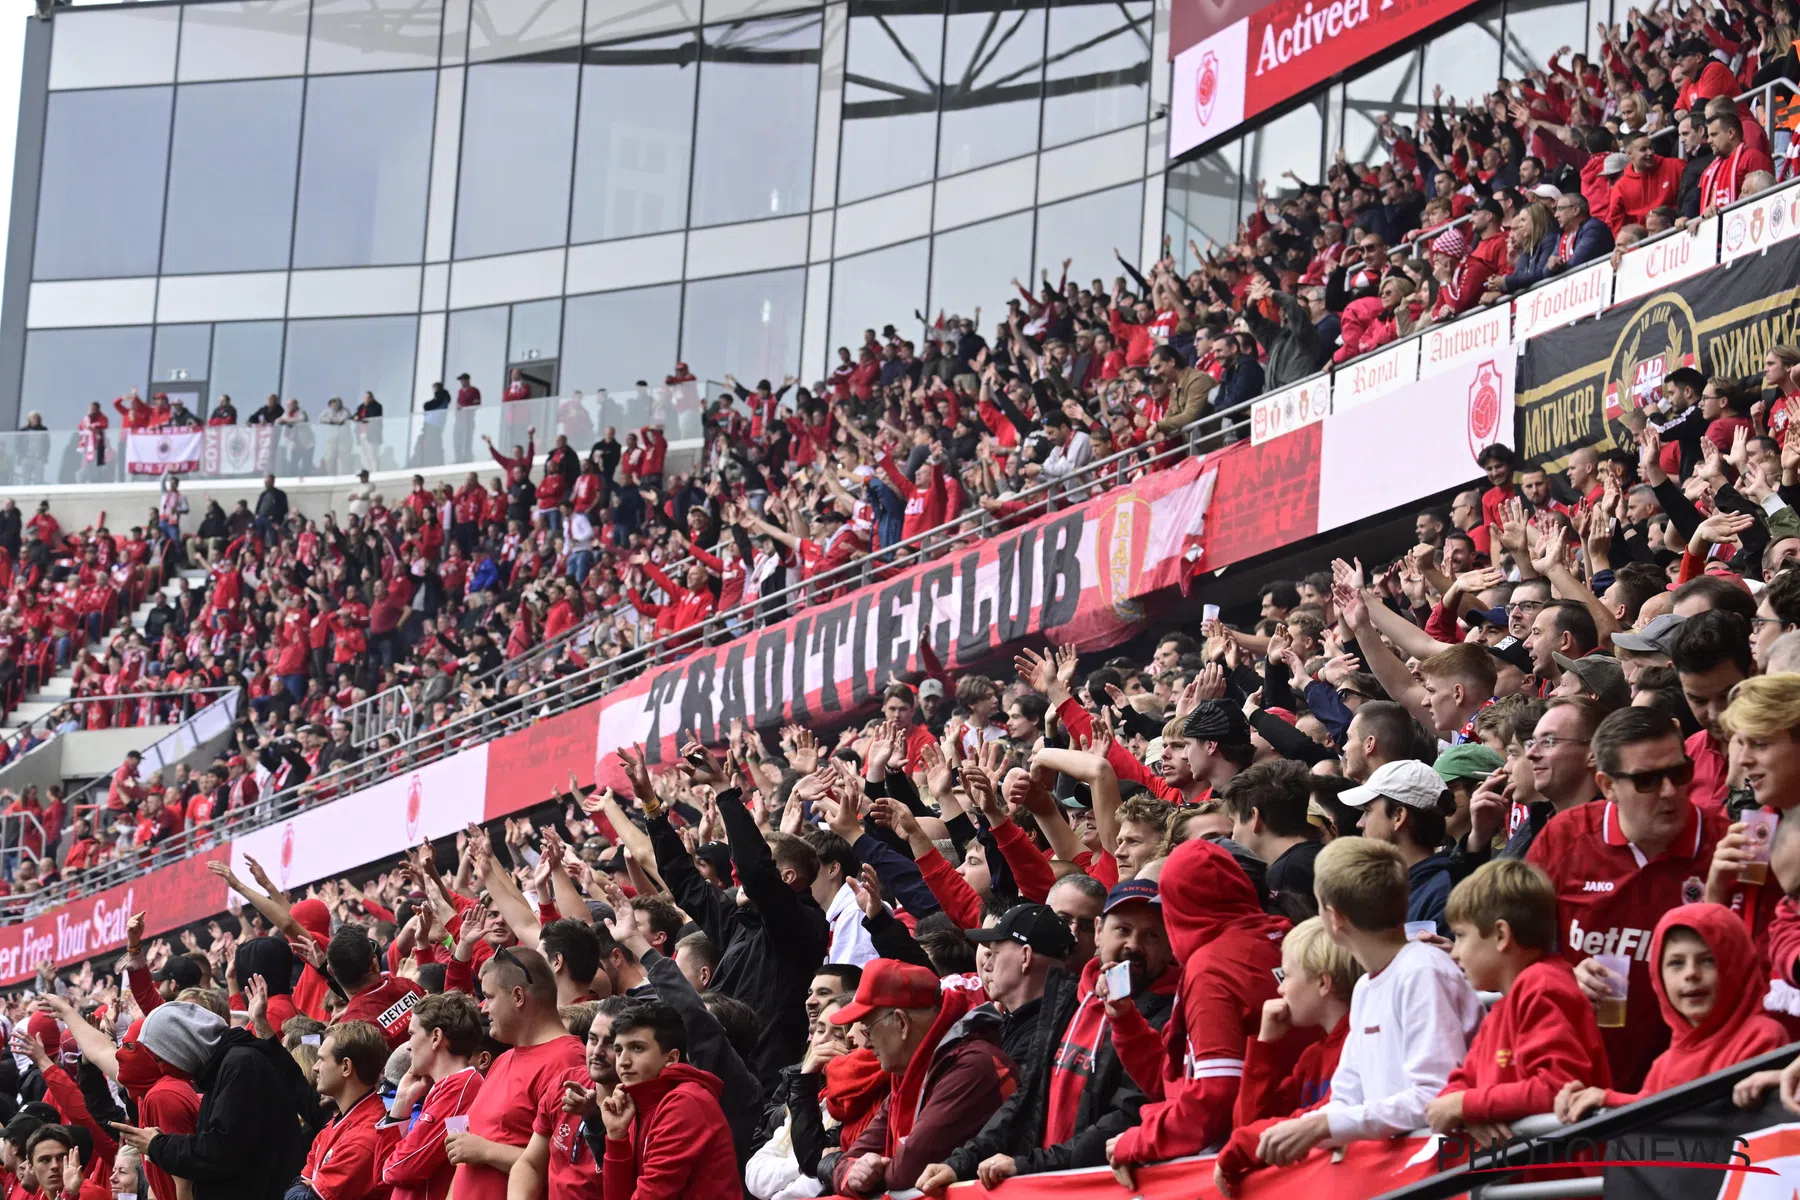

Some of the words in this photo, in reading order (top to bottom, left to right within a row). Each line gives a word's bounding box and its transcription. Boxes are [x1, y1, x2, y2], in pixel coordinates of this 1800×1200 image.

[1352, 351, 1399, 394] Royal
[1430, 319, 1500, 362] Antwerp
[1524, 267, 1603, 333] Football
[1646, 236, 1690, 279] Club
[1524, 385, 1594, 460] ANTWERP
[643, 508, 1084, 765] TRADITIECLUB
[1583, 881, 1615, 892] JAKO
[20, 926, 54, 975] Free
[55, 912, 91, 961] Your
[1569, 918, 1652, 963] betFI
[380, 992, 419, 1027] HEYLEN
